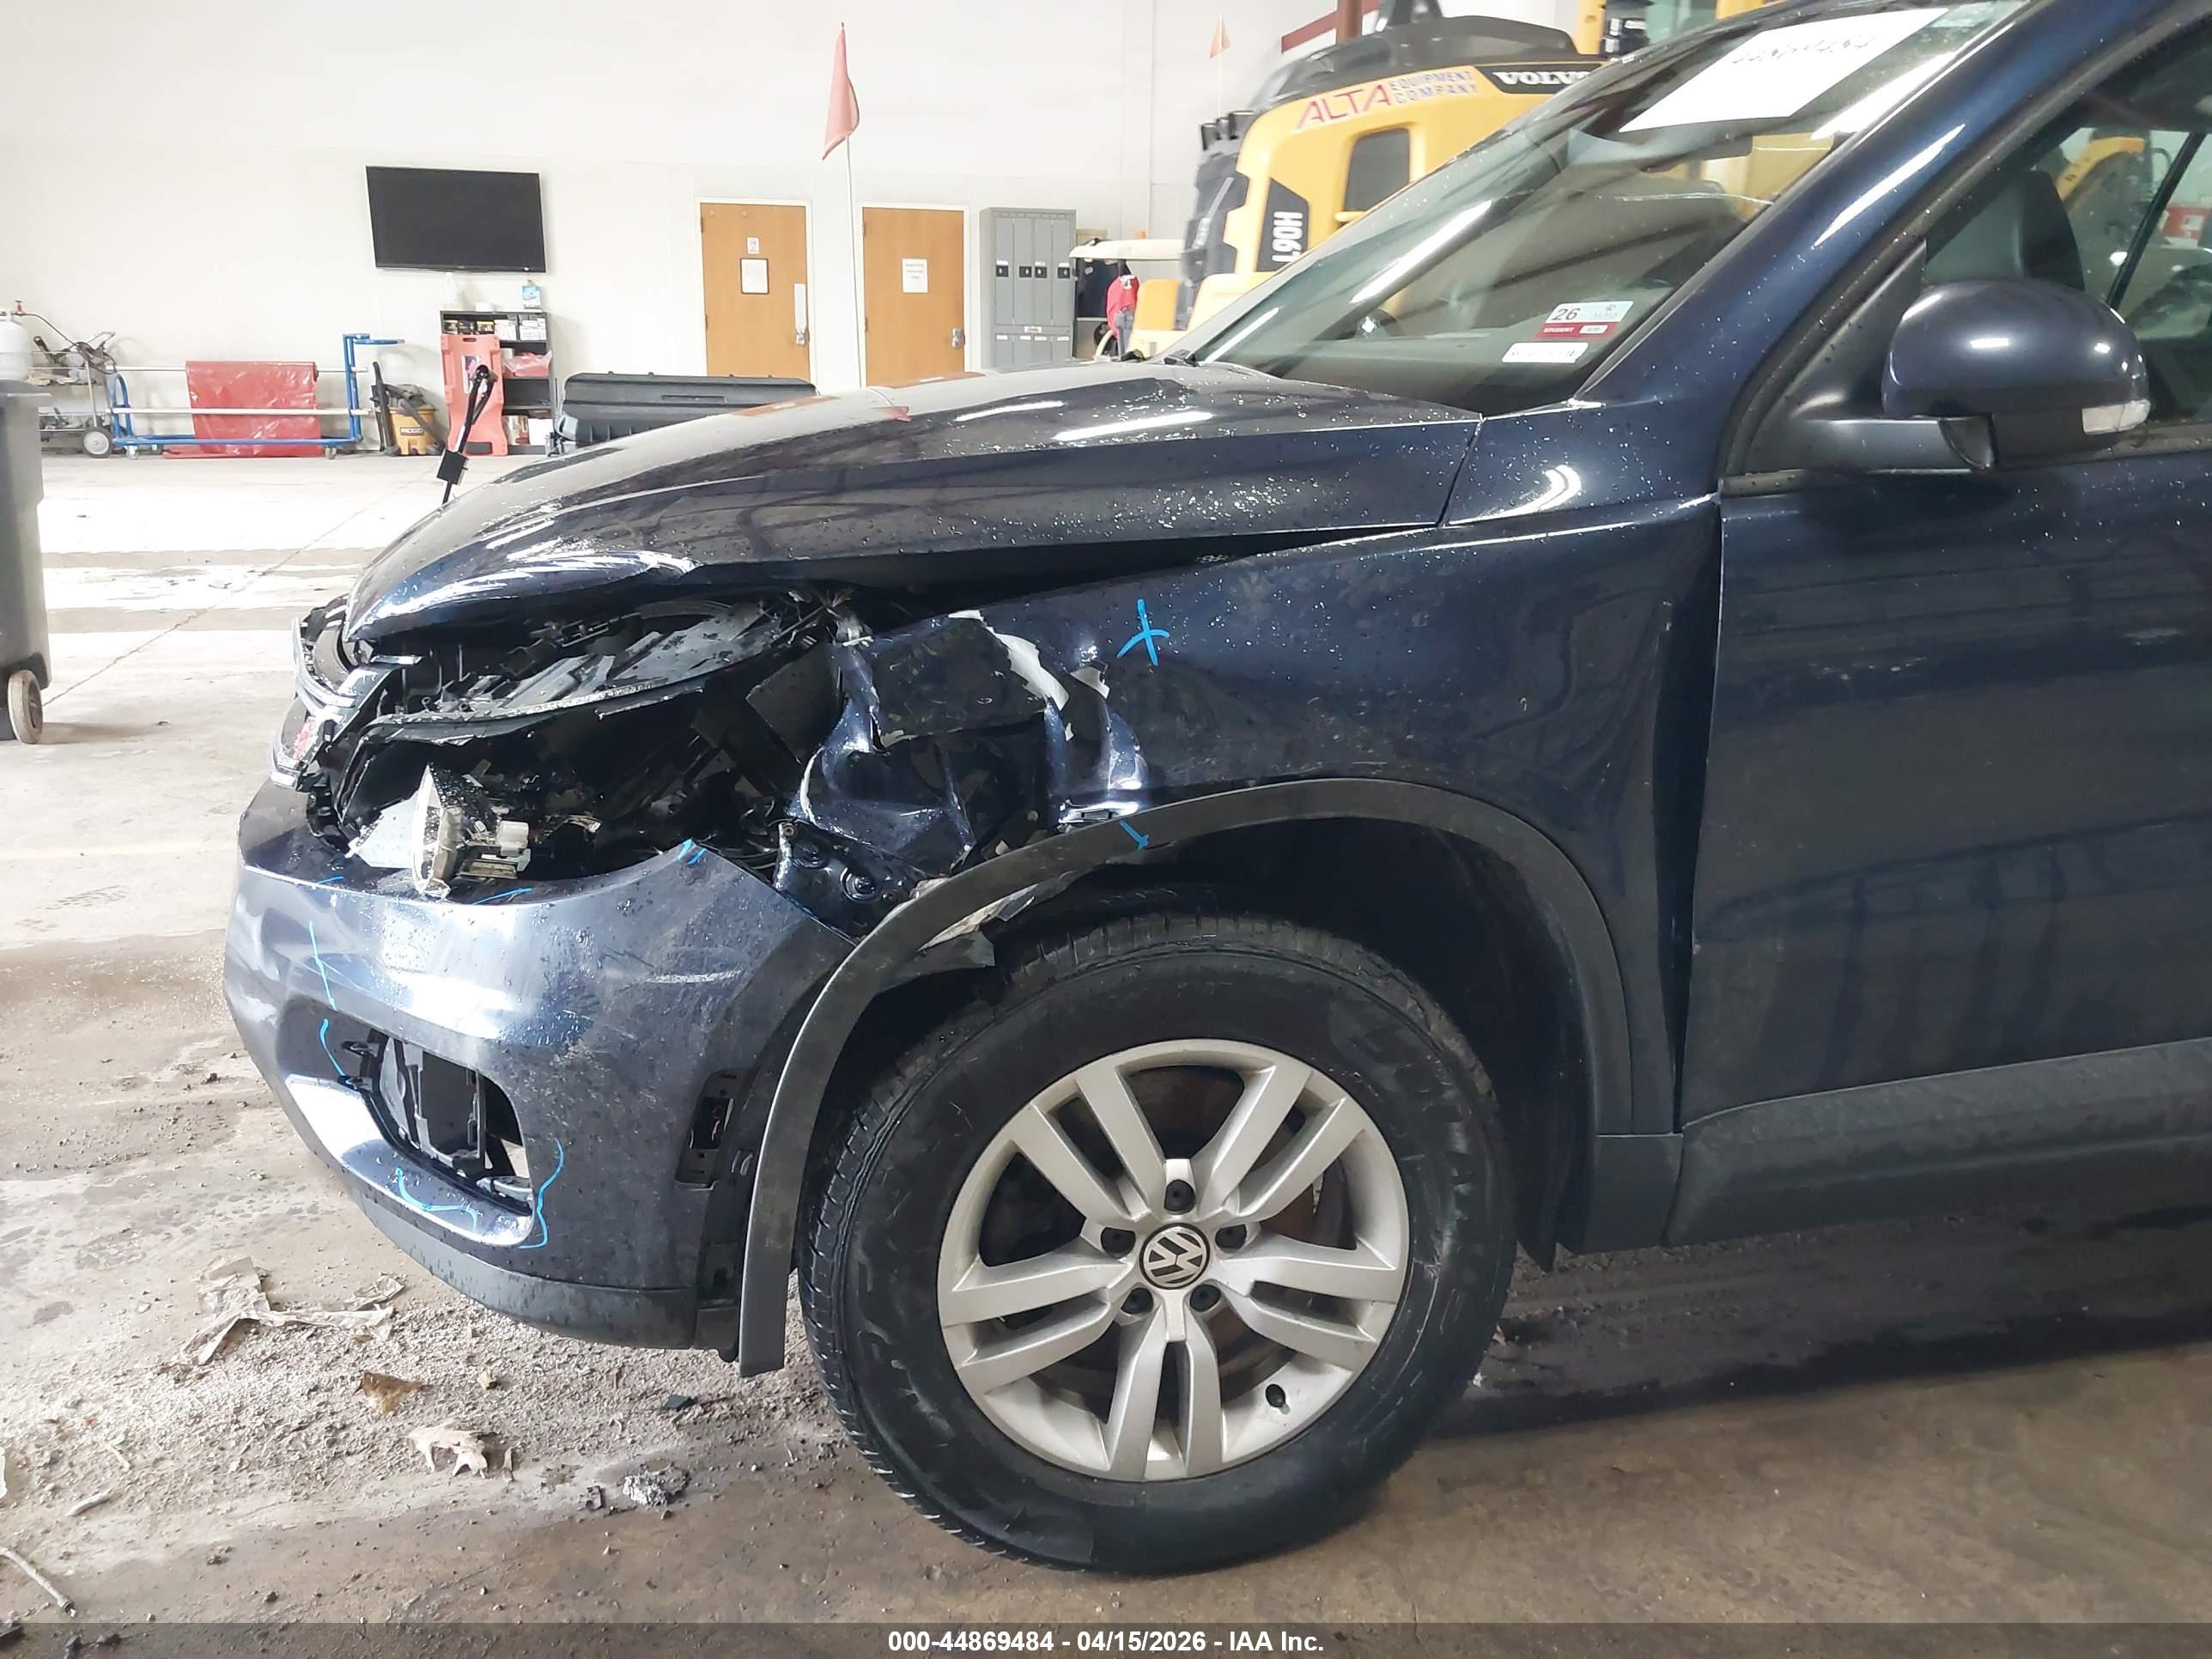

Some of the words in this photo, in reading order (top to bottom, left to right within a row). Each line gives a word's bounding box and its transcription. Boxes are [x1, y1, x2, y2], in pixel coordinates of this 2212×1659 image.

[1388, 70, 1472, 91] EQUIPMENT
[1393, 83, 1479, 104] COMPANY
[1296, 84, 1391, 129] ALTA
[1272, 210, 1304, 263] L90H
[1552, 307, 1581, 321] 26
